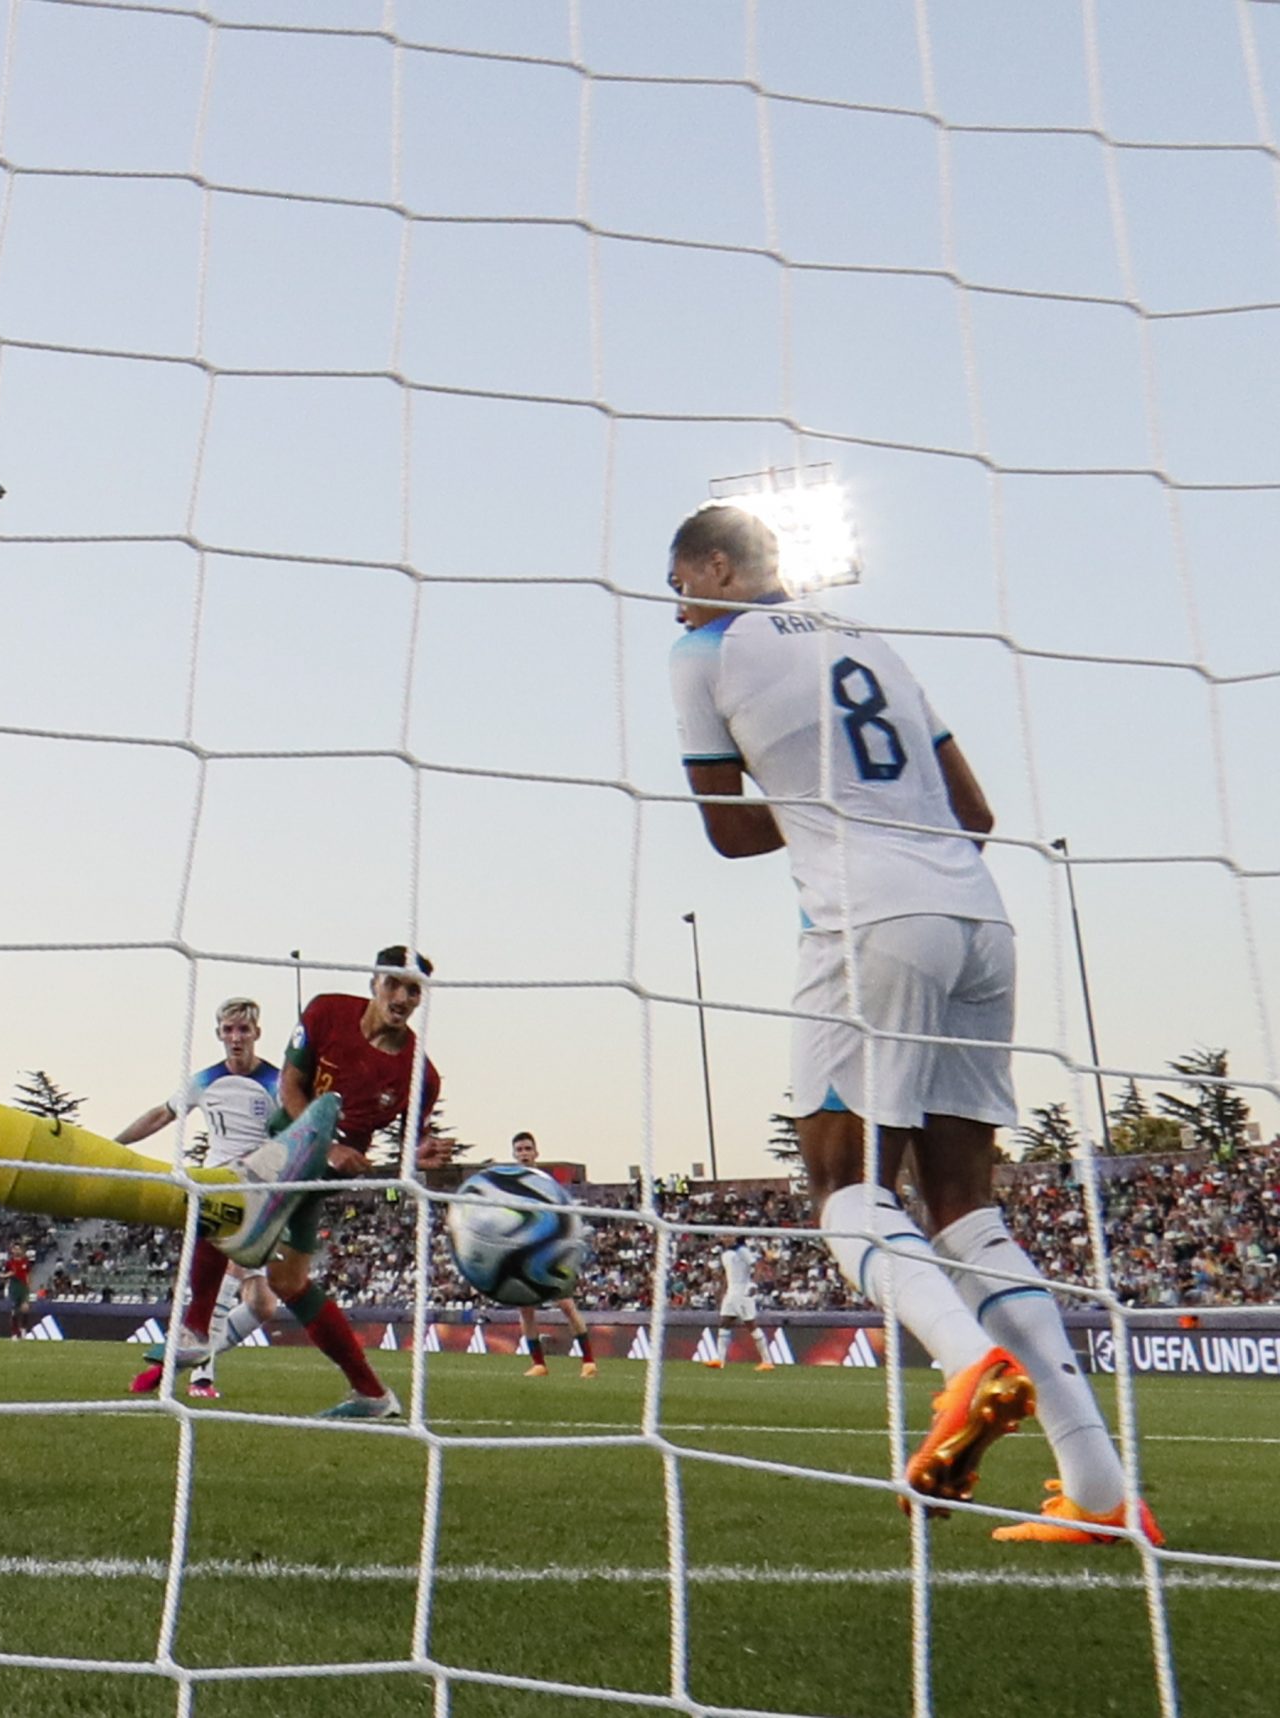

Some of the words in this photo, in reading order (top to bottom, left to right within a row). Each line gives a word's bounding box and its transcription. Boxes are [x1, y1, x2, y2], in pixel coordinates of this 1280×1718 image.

[831, 656, 907, 781] 8
[209, 1111, 226, 1136] 11
[1132, 1336, 1200, 1372] UEFA
[1201, 1337, 1280, 1374] UNDE
